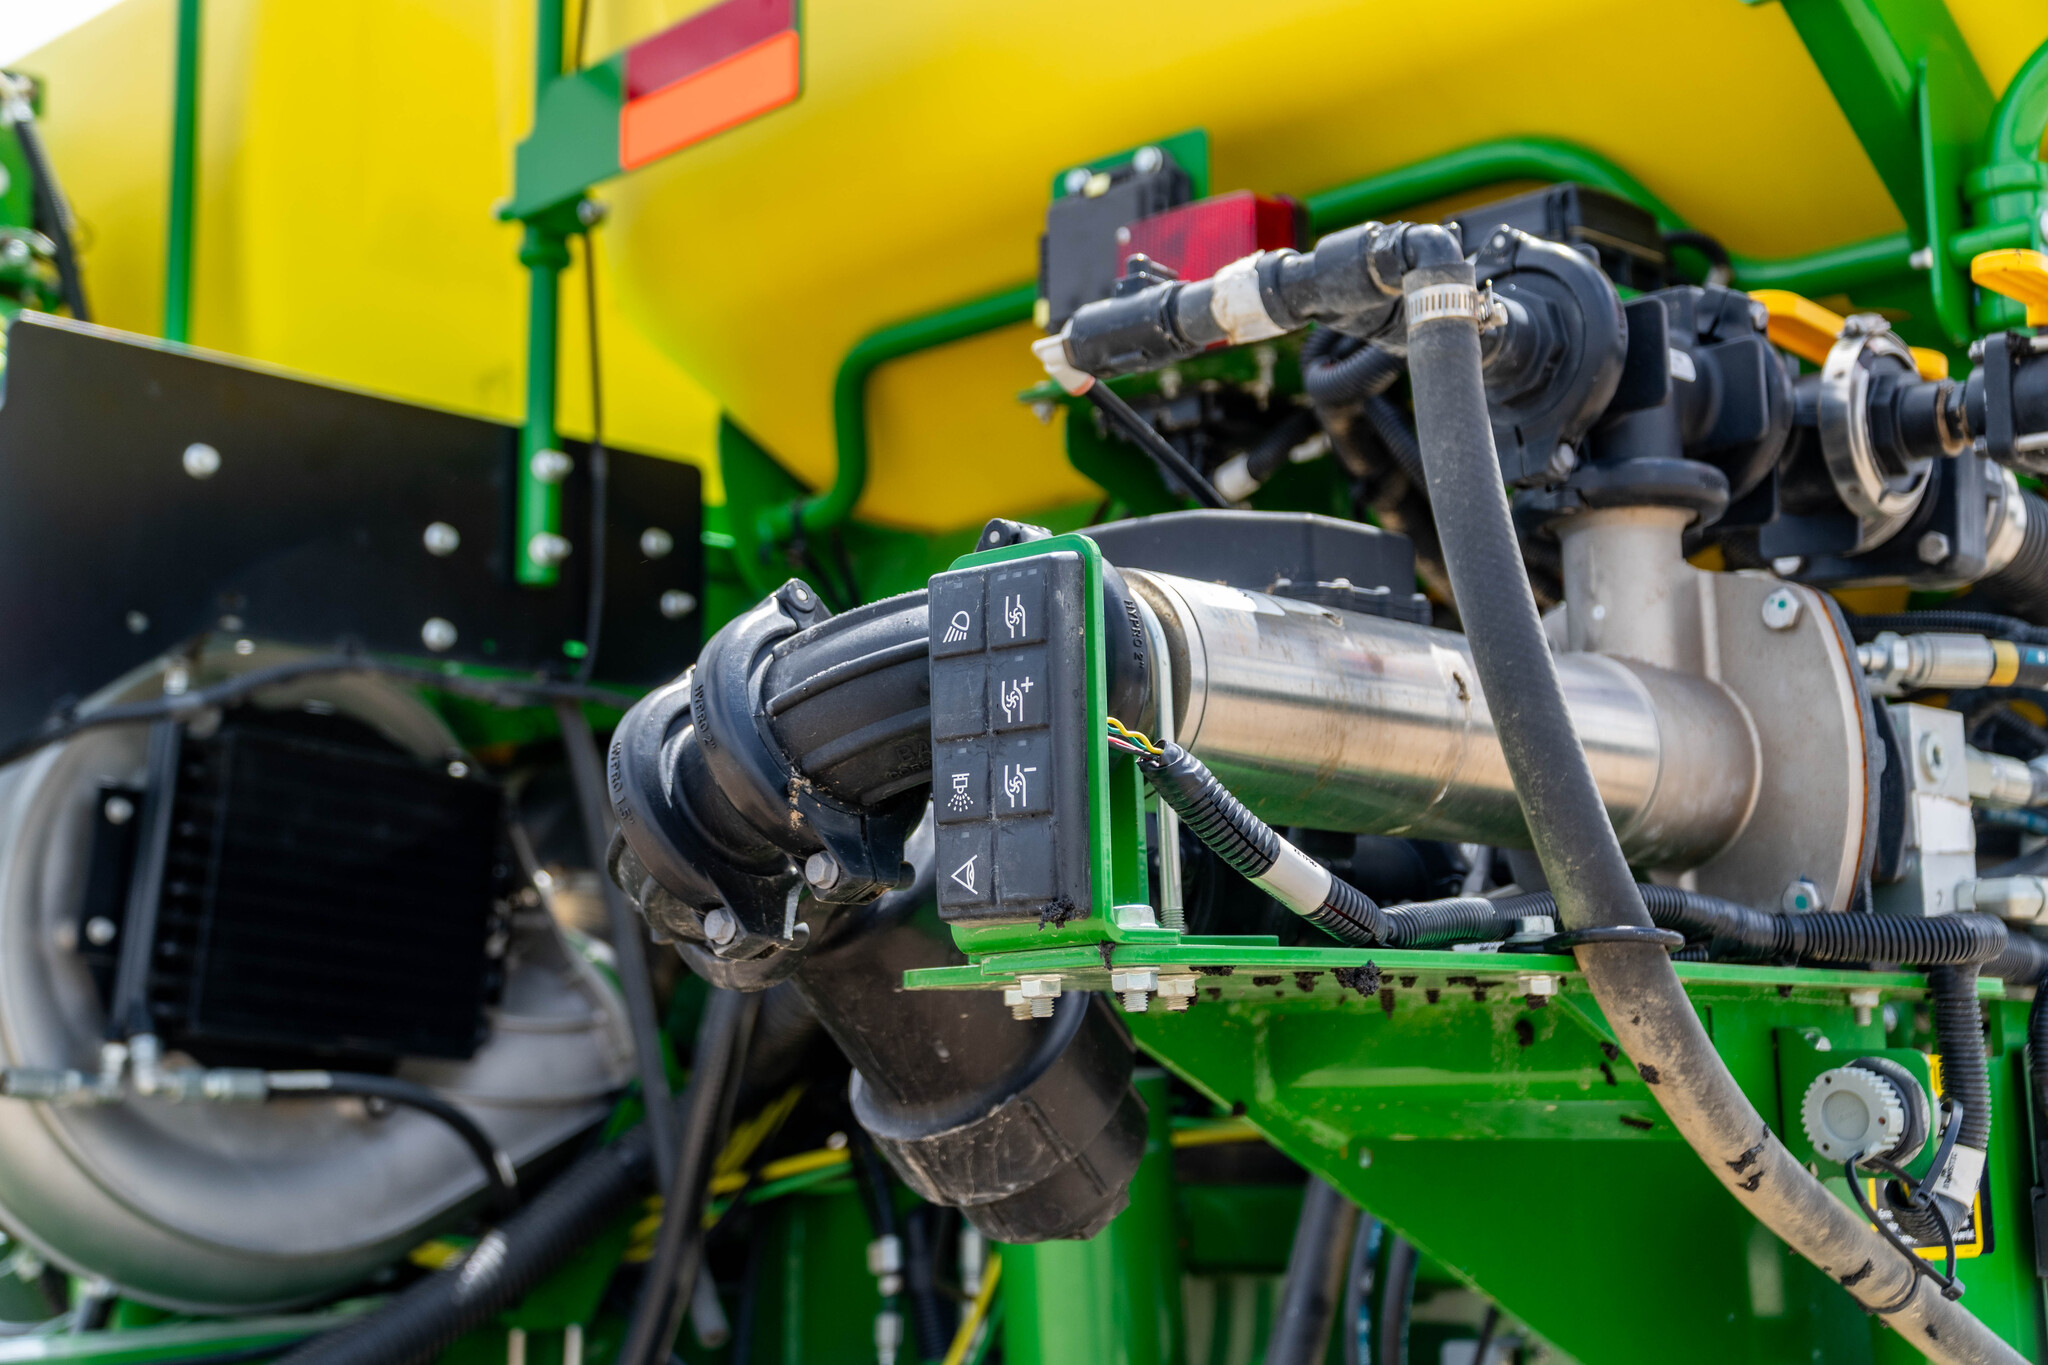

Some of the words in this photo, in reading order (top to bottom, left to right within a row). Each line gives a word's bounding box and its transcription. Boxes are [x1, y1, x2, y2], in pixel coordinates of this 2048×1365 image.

[1123, 599, 1143, 648] HYPRO
[694, 684, 709, 733] HYPRO
[610, 740, 623, 793] HYPRO
